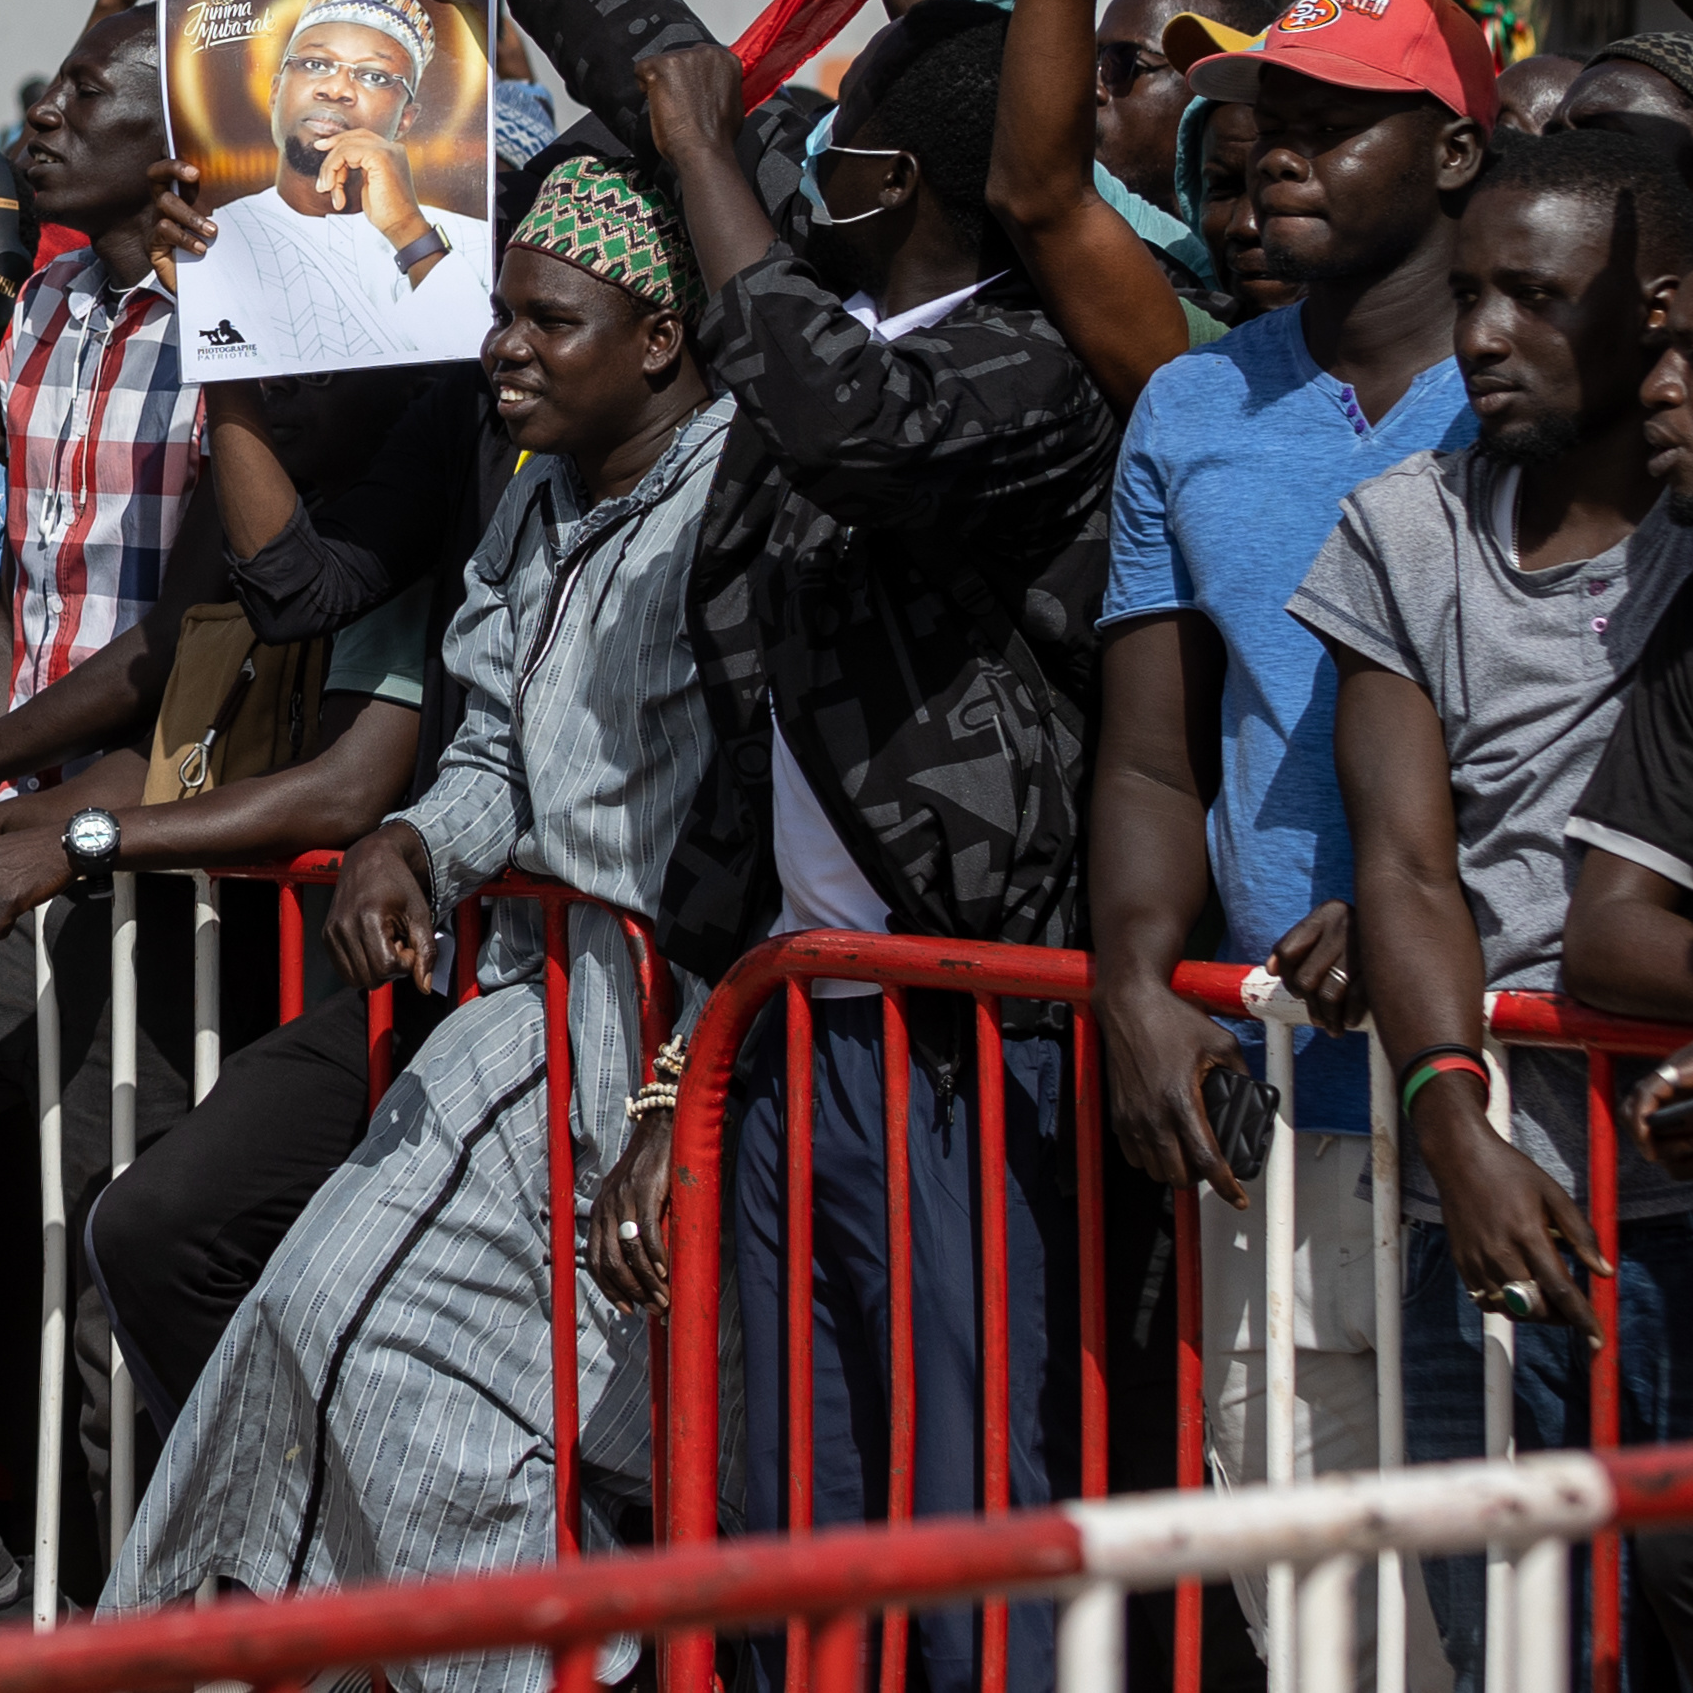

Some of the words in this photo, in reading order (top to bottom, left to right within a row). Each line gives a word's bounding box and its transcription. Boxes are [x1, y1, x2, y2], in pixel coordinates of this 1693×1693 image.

[183, 1, 253, 37] Jumma
[190, 8, 278, 49] Mubarak
[197, 344, 258, 355] PHOTOGRAPHE
